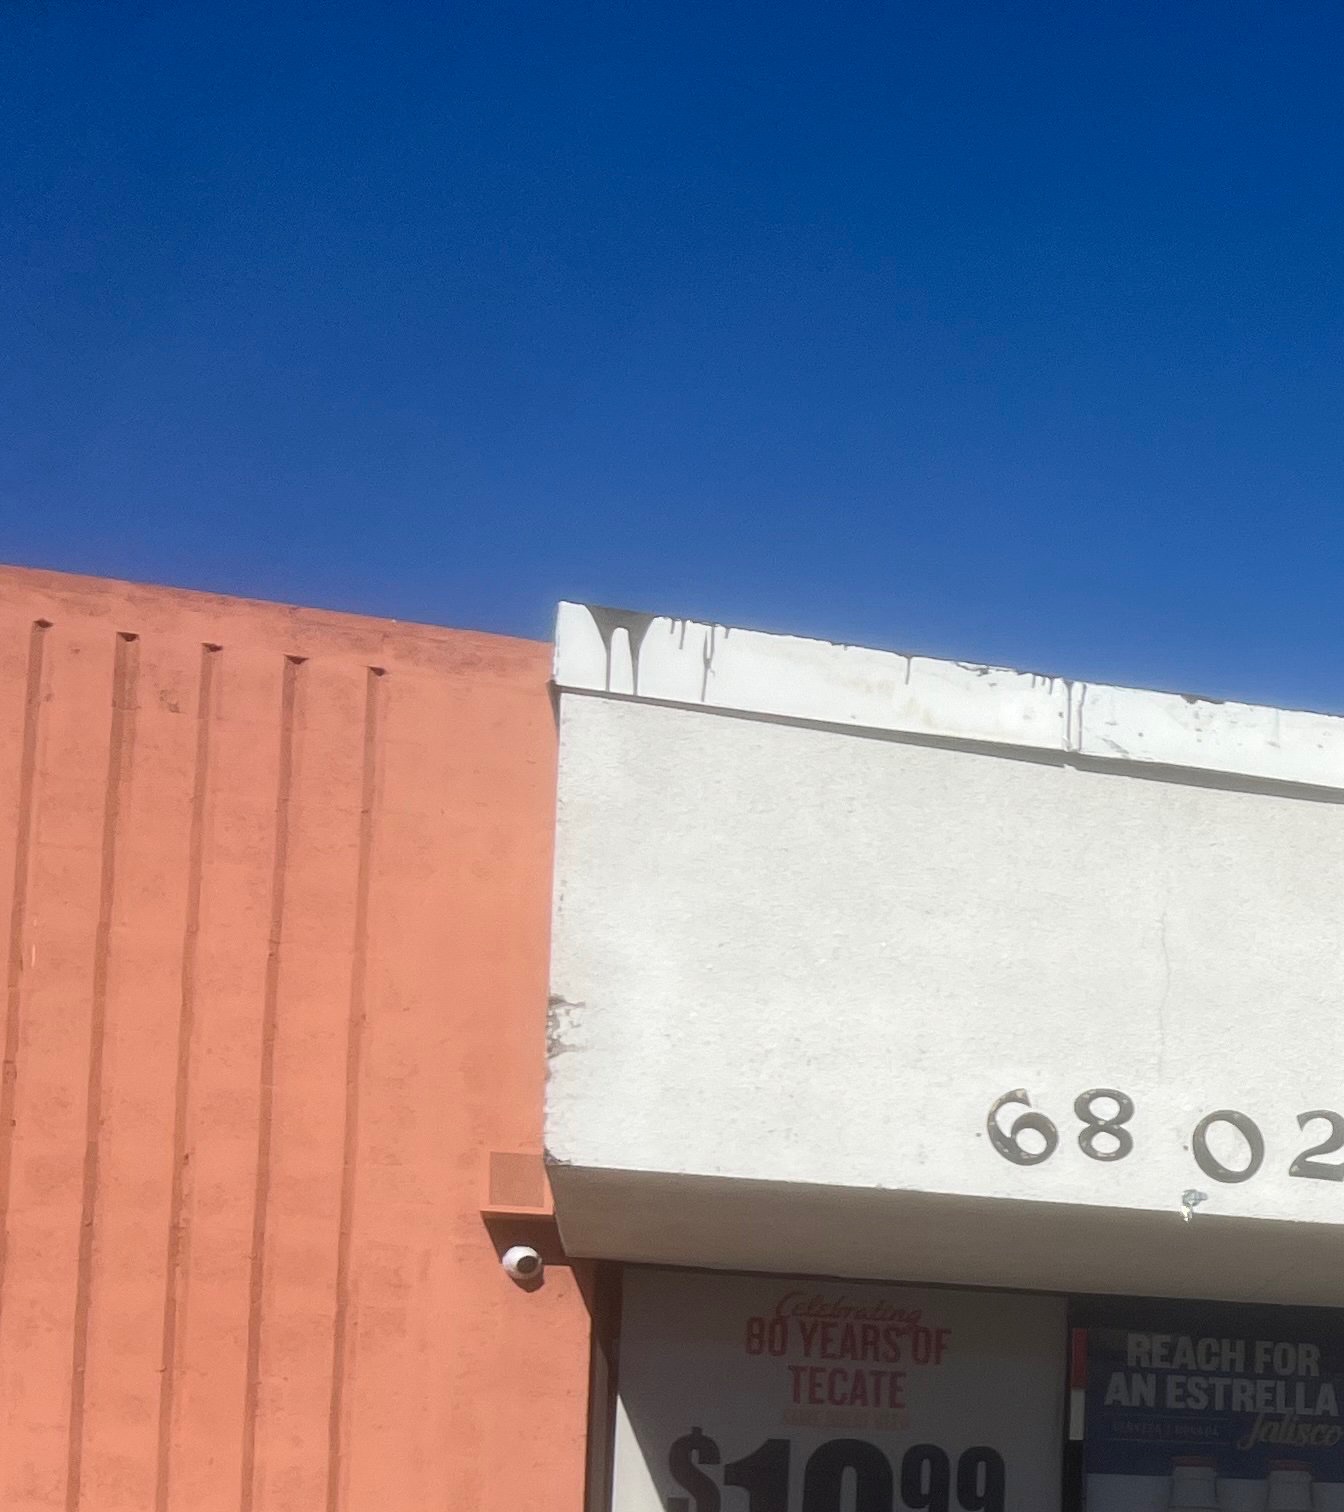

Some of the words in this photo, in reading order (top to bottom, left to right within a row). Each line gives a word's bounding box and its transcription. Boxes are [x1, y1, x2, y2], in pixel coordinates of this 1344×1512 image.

[746, 1317, 788, 1356] 80
[799, 1319, 901, 1363] YEARS
[912, 1325, 952, 1365] OF
[1127, 1333, 1246, 1373] REACH
[1255, 1340, 1321, 1376] FOR
[788, 1365, 906, 1408] TECATE
[1104, 1372, 1156, 1408] AN
[1166, 1375, 1339, 1416] ESTRELLA
[1236, 1409, 1344, 1449] Jalisco
